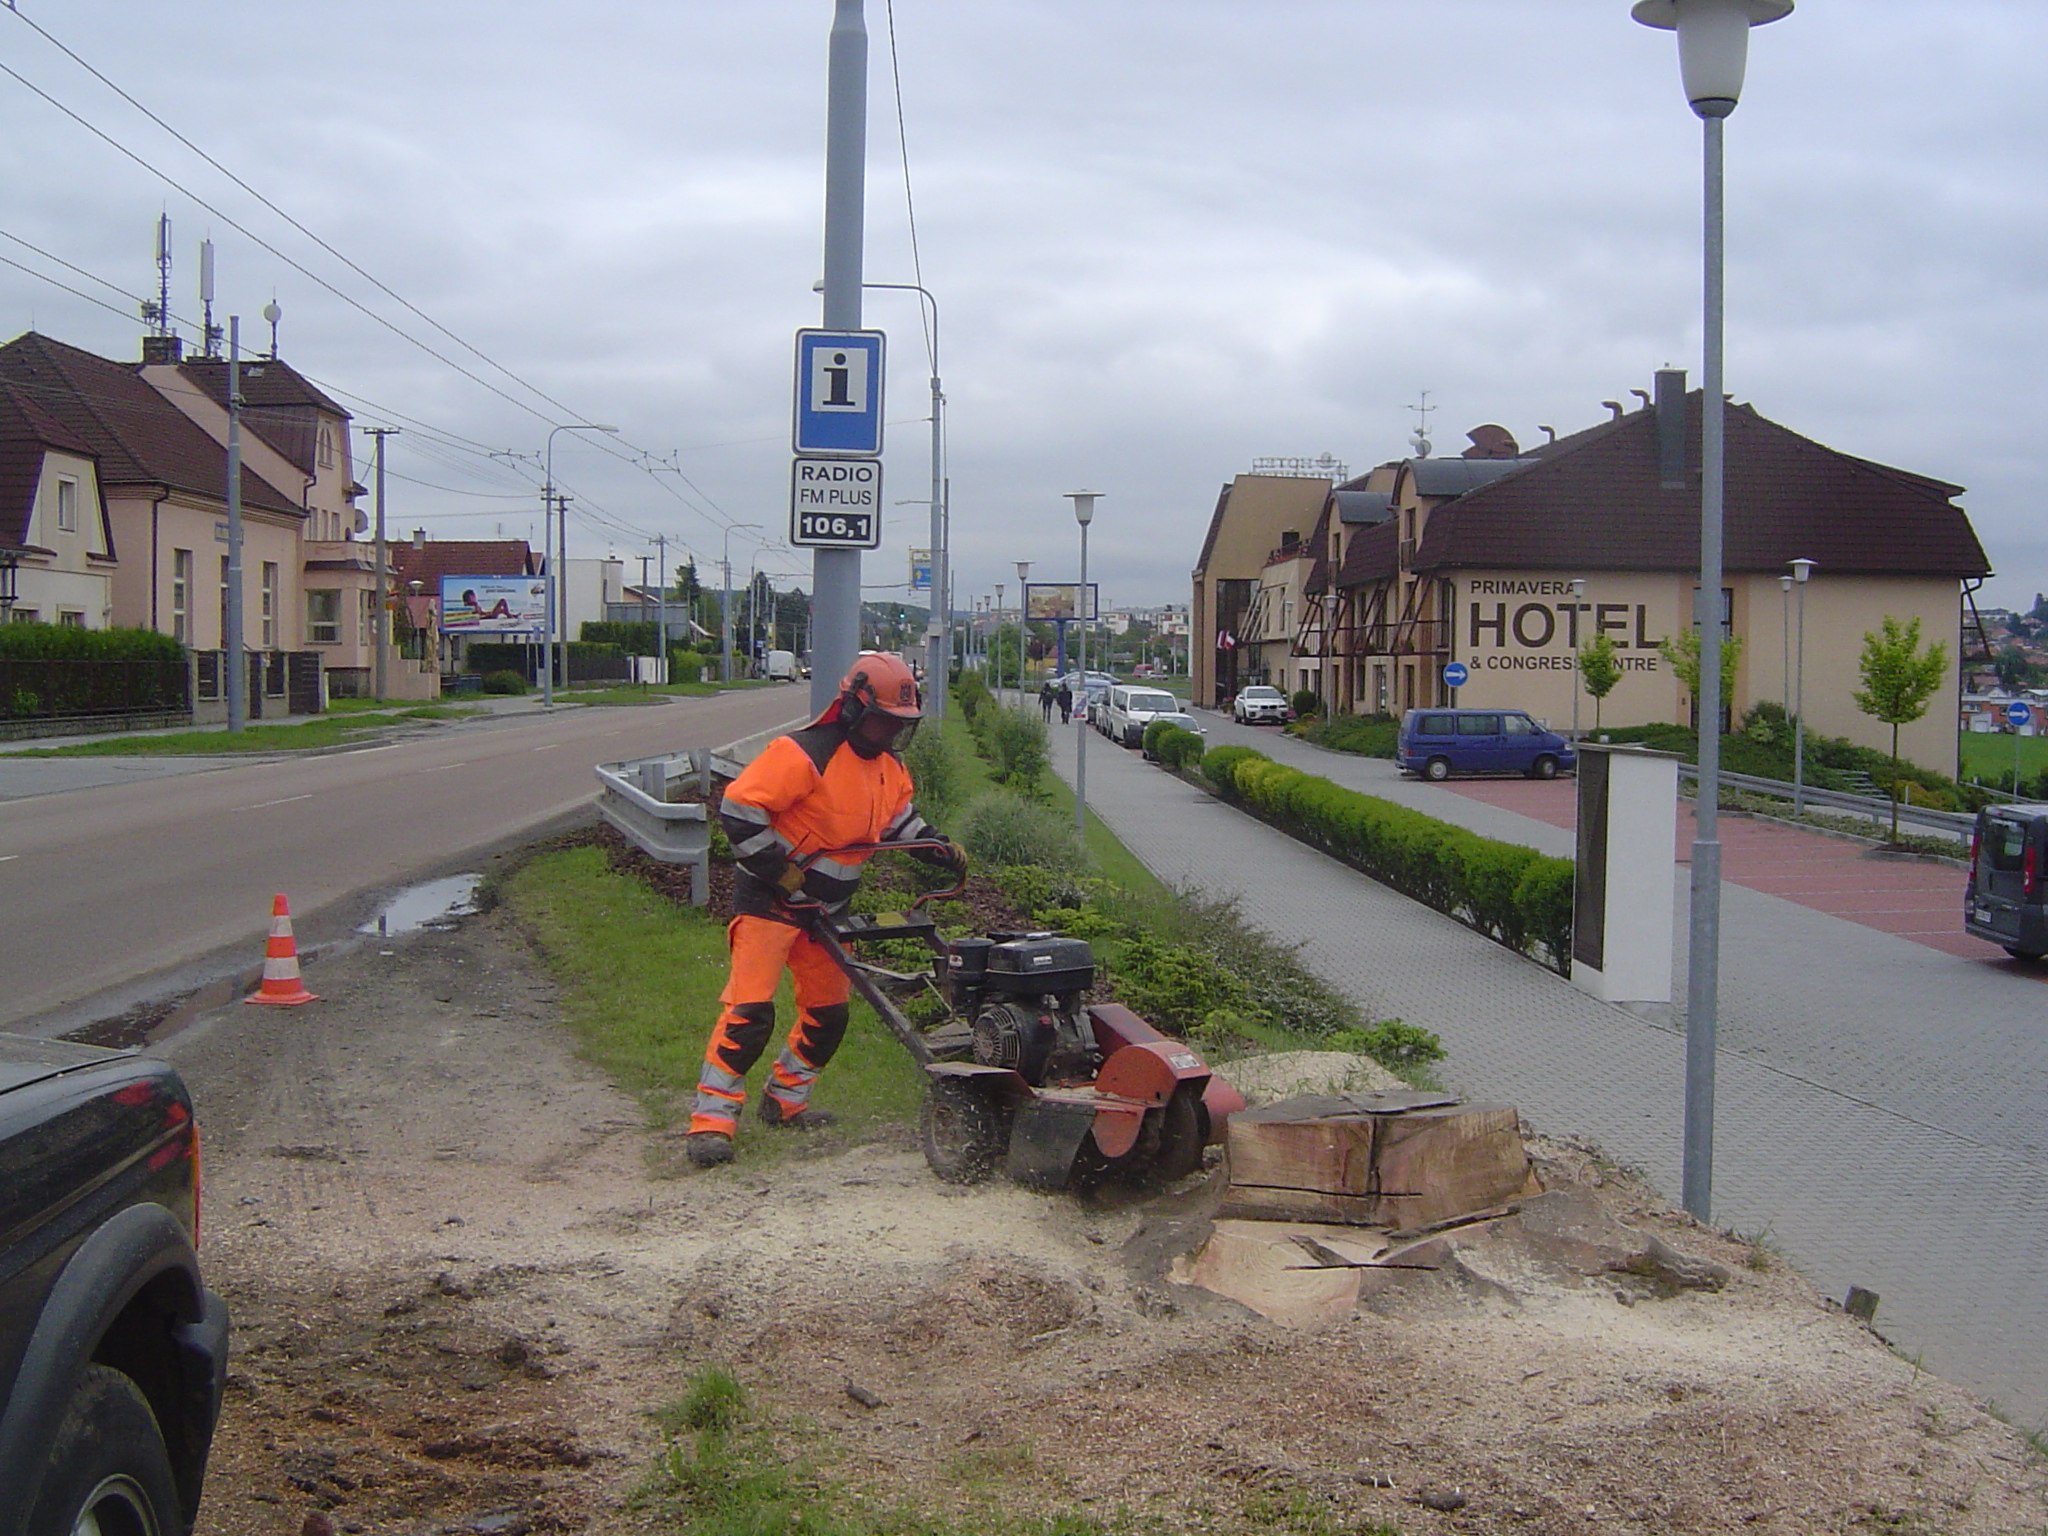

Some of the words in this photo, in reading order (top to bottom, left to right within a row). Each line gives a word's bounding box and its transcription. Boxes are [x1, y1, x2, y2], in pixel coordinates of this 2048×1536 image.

[801, 466, 873, 482] RADIO
[801, 488, 824, 504] FM
[829, 489, 872, 505] PLUS
[802, 516, 867, 538] 106,1
[1470, 580, 1576, 595] PRIMAVERA
[1470, 602, 1666, 649] HOTEL
[1470, 656, 1481, 669] &
[1590, 657, 1657, 671] NTRE
